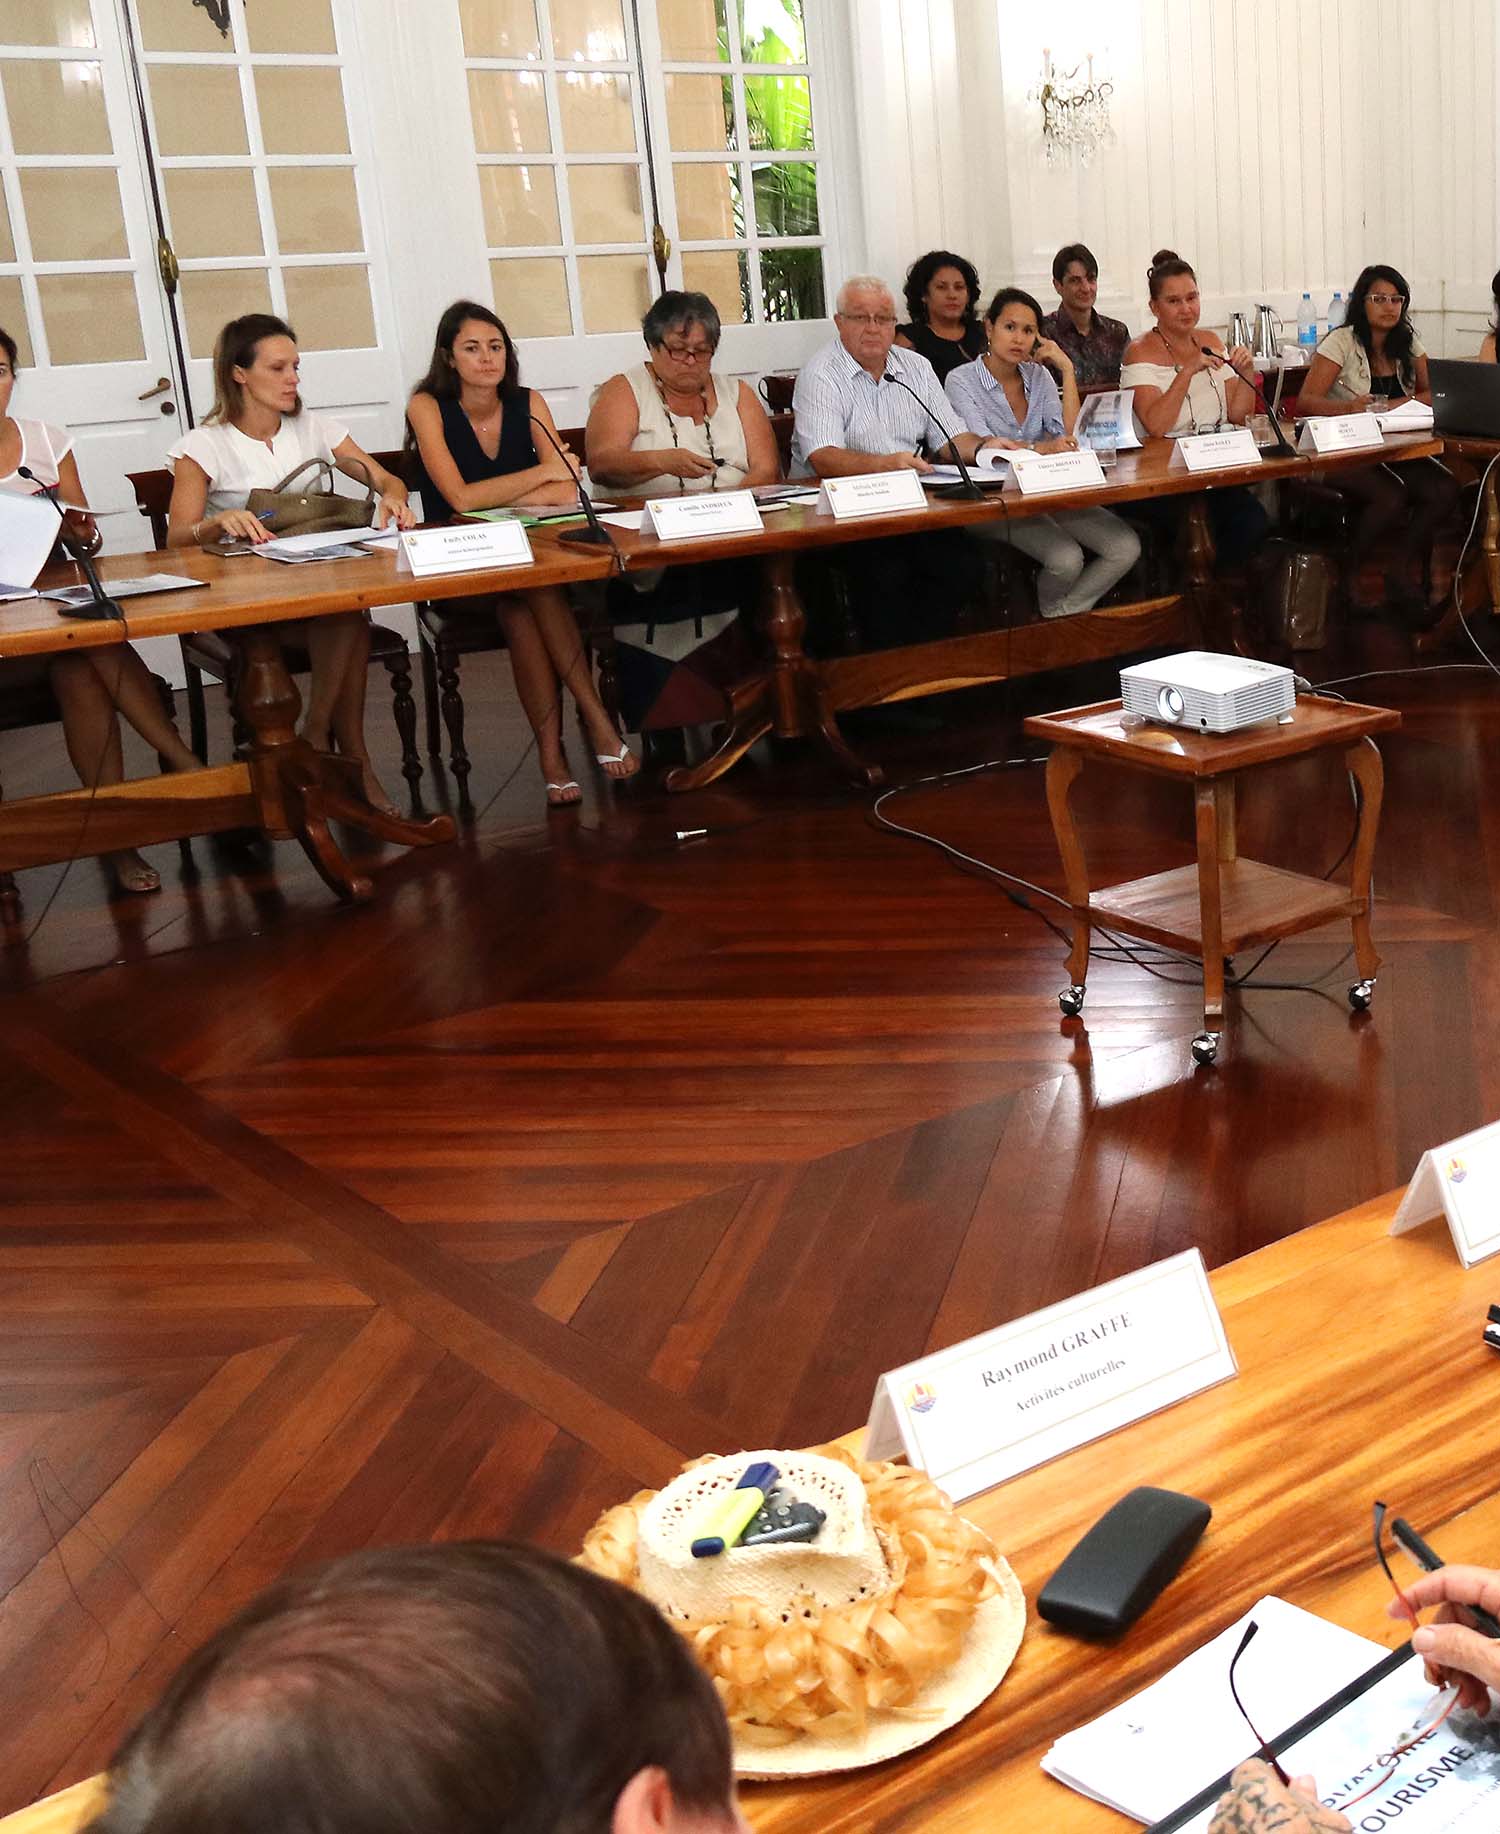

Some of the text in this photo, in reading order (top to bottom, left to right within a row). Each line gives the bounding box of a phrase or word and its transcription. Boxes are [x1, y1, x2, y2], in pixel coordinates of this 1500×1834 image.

[981, 1312, 1134, 1388] Raymond GRAFFE
[1016, 1358, 1127, 1412] Activités culturelles
[1352, 1744, 1477, 1834] OURISME
